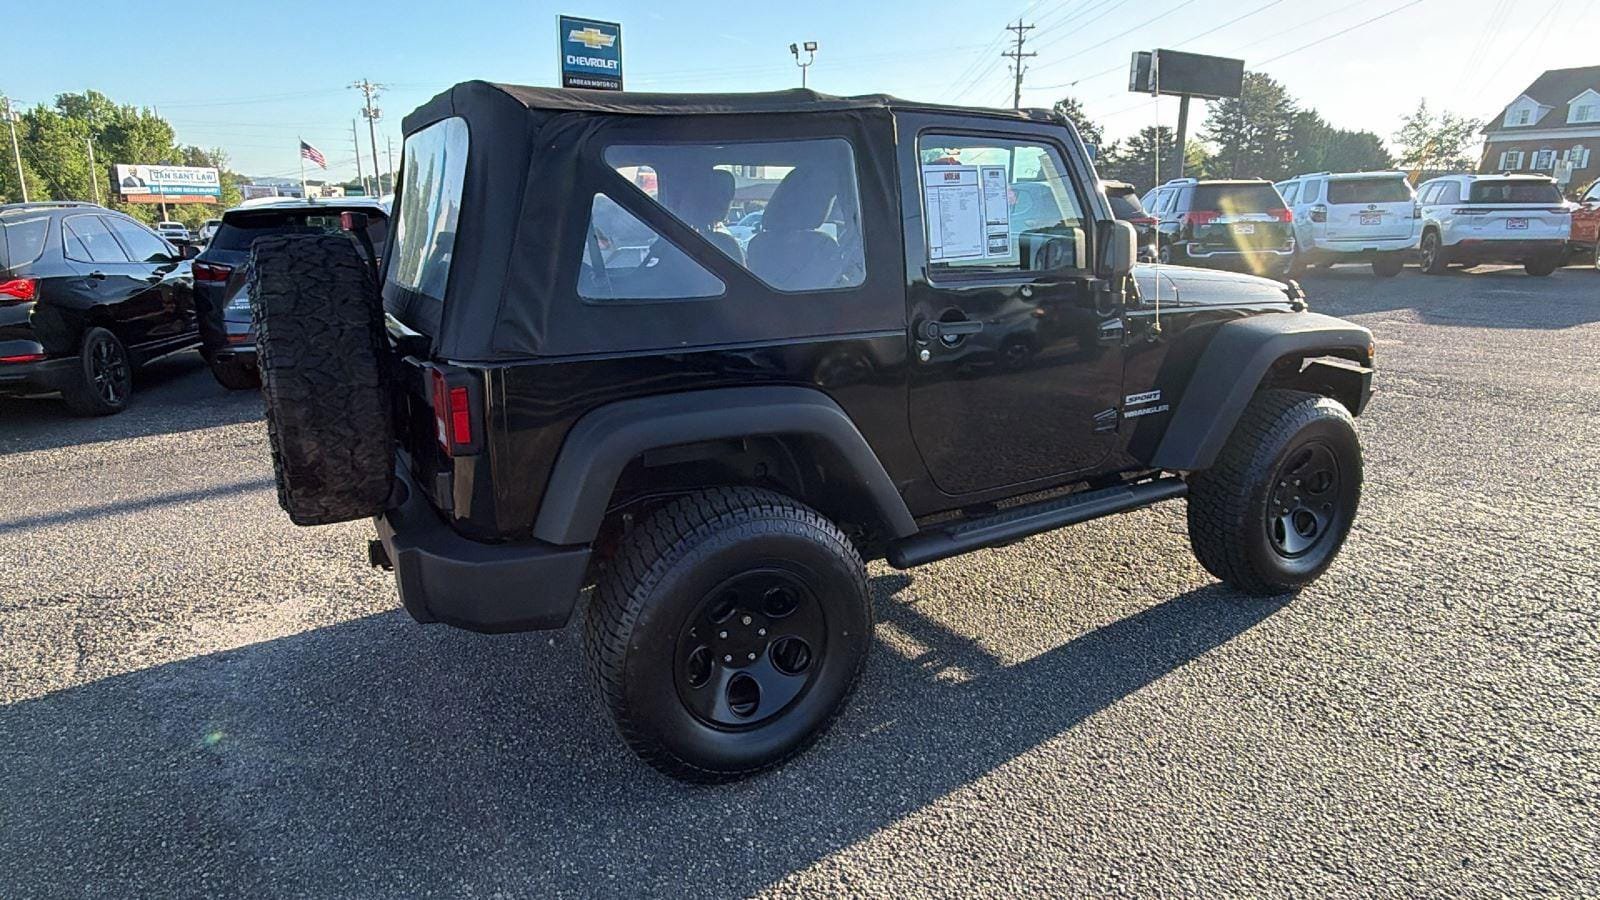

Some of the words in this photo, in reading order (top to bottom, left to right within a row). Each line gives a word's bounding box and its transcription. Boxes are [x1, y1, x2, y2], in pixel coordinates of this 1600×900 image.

[566, 55, 618, 69] CHEVROLET
[591, 80, 610, 88] MOTOR
[172, 172, 194, 180] SANT
[195, 173, 213, 181] LAW
[1128, 392, 1158, 401] SPORT
[1124, 404, 1169, 418] WRANGLER
